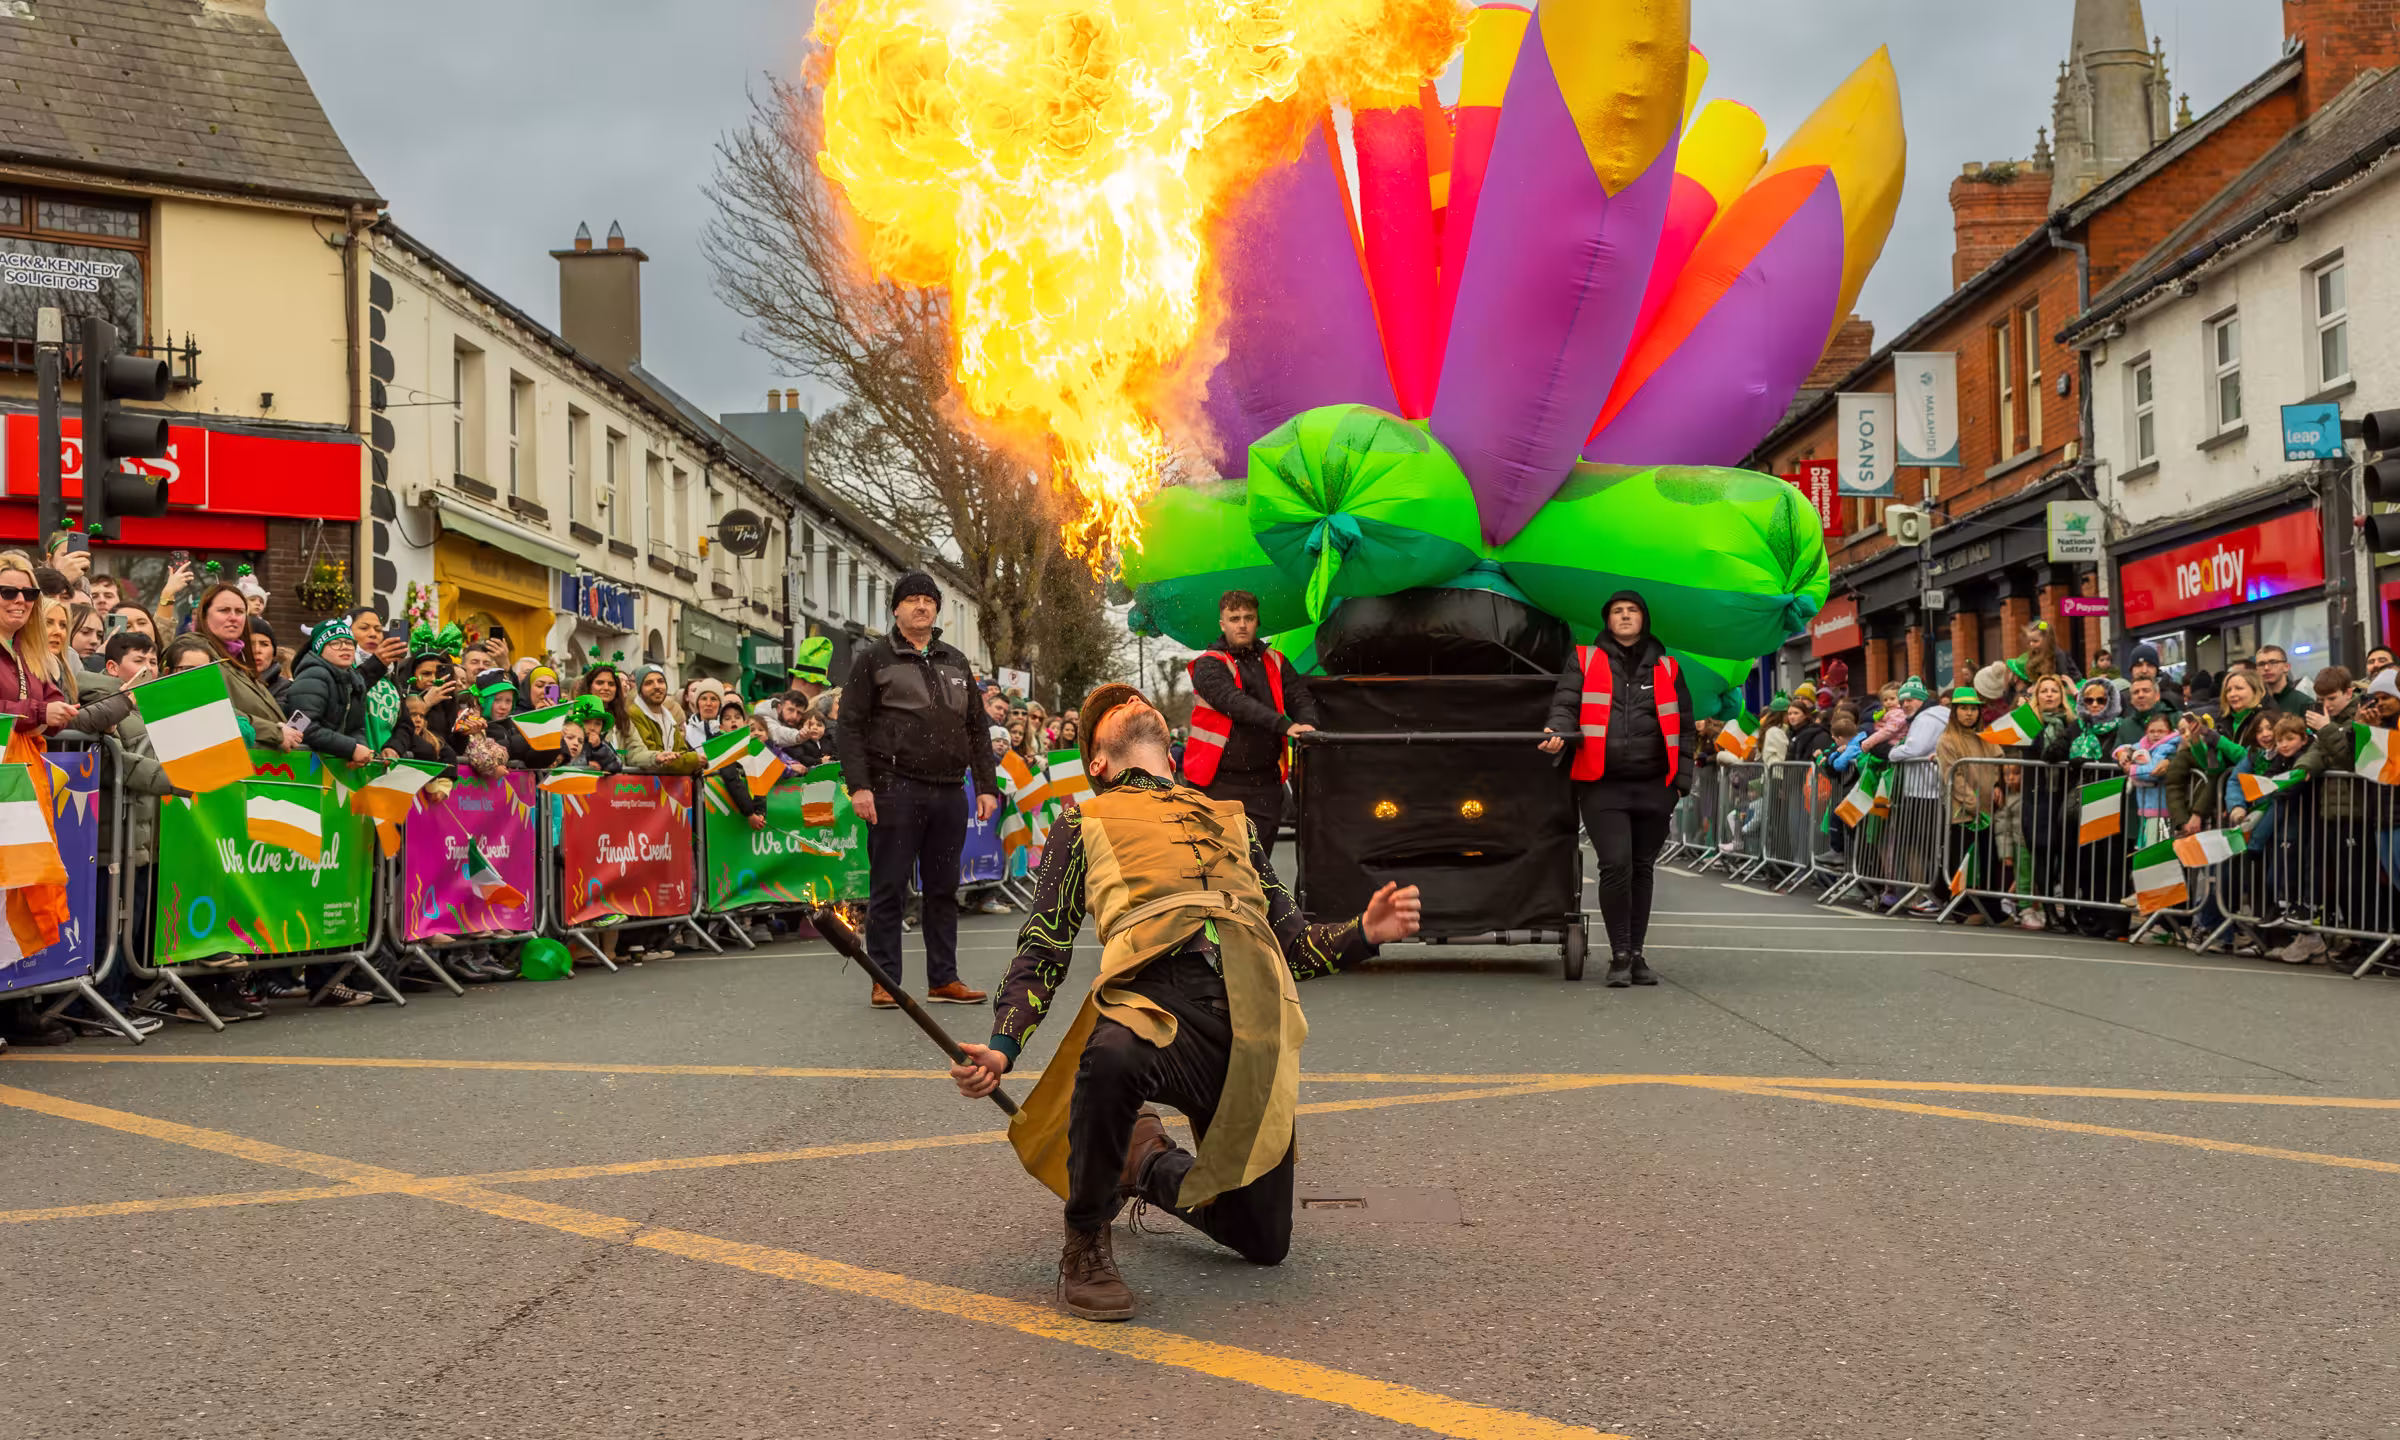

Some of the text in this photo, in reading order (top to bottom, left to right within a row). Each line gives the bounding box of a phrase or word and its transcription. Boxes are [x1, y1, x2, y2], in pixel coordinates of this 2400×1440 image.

[5, 269, 99, 291] SOLICITORS
[34, 257, 46, 270] &
[47, 257, 122, 278] KENNEDY
[1925, 395, 1937, 453] MALAHIDE
[1858, 410, 1875, 482] LOANS
[2287, 430, 2320, 446] leap
[1820, 467, 1832, 529] Appliances
[2057, 537, 2096, 546] National
[2060, 546, 2095, 554] Lottery
[2176, 543, 2244, 600] nearby
[314, 625, 354, 651] IRELAN
[215, 837, 245, 874] We
[247, 840, 282, 874] Are
[596, 830, 673, 877] Fingal Events
[752, 831, 783, 855] We
